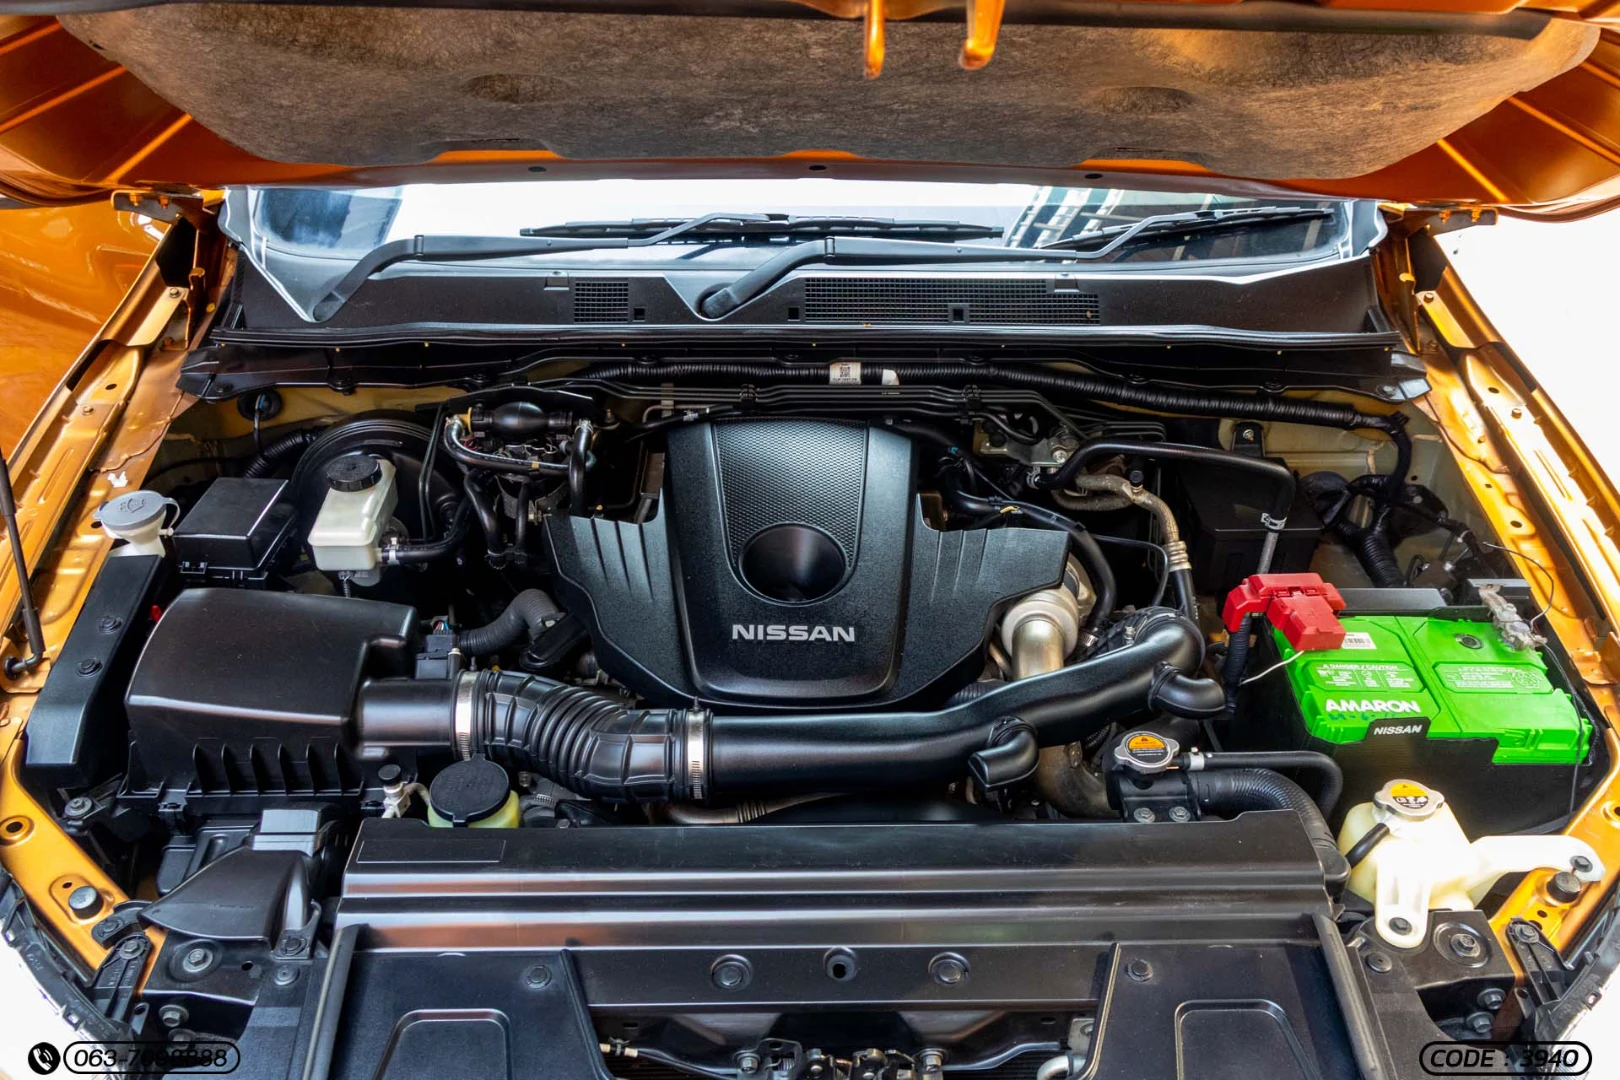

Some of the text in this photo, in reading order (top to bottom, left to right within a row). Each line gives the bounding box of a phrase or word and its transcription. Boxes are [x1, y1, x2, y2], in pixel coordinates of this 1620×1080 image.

[732, 624, 855, 642] NISSAN
[1325, 698, 1422, 714] AMARON
[1373, 724, 1423, 735] NISSAN
